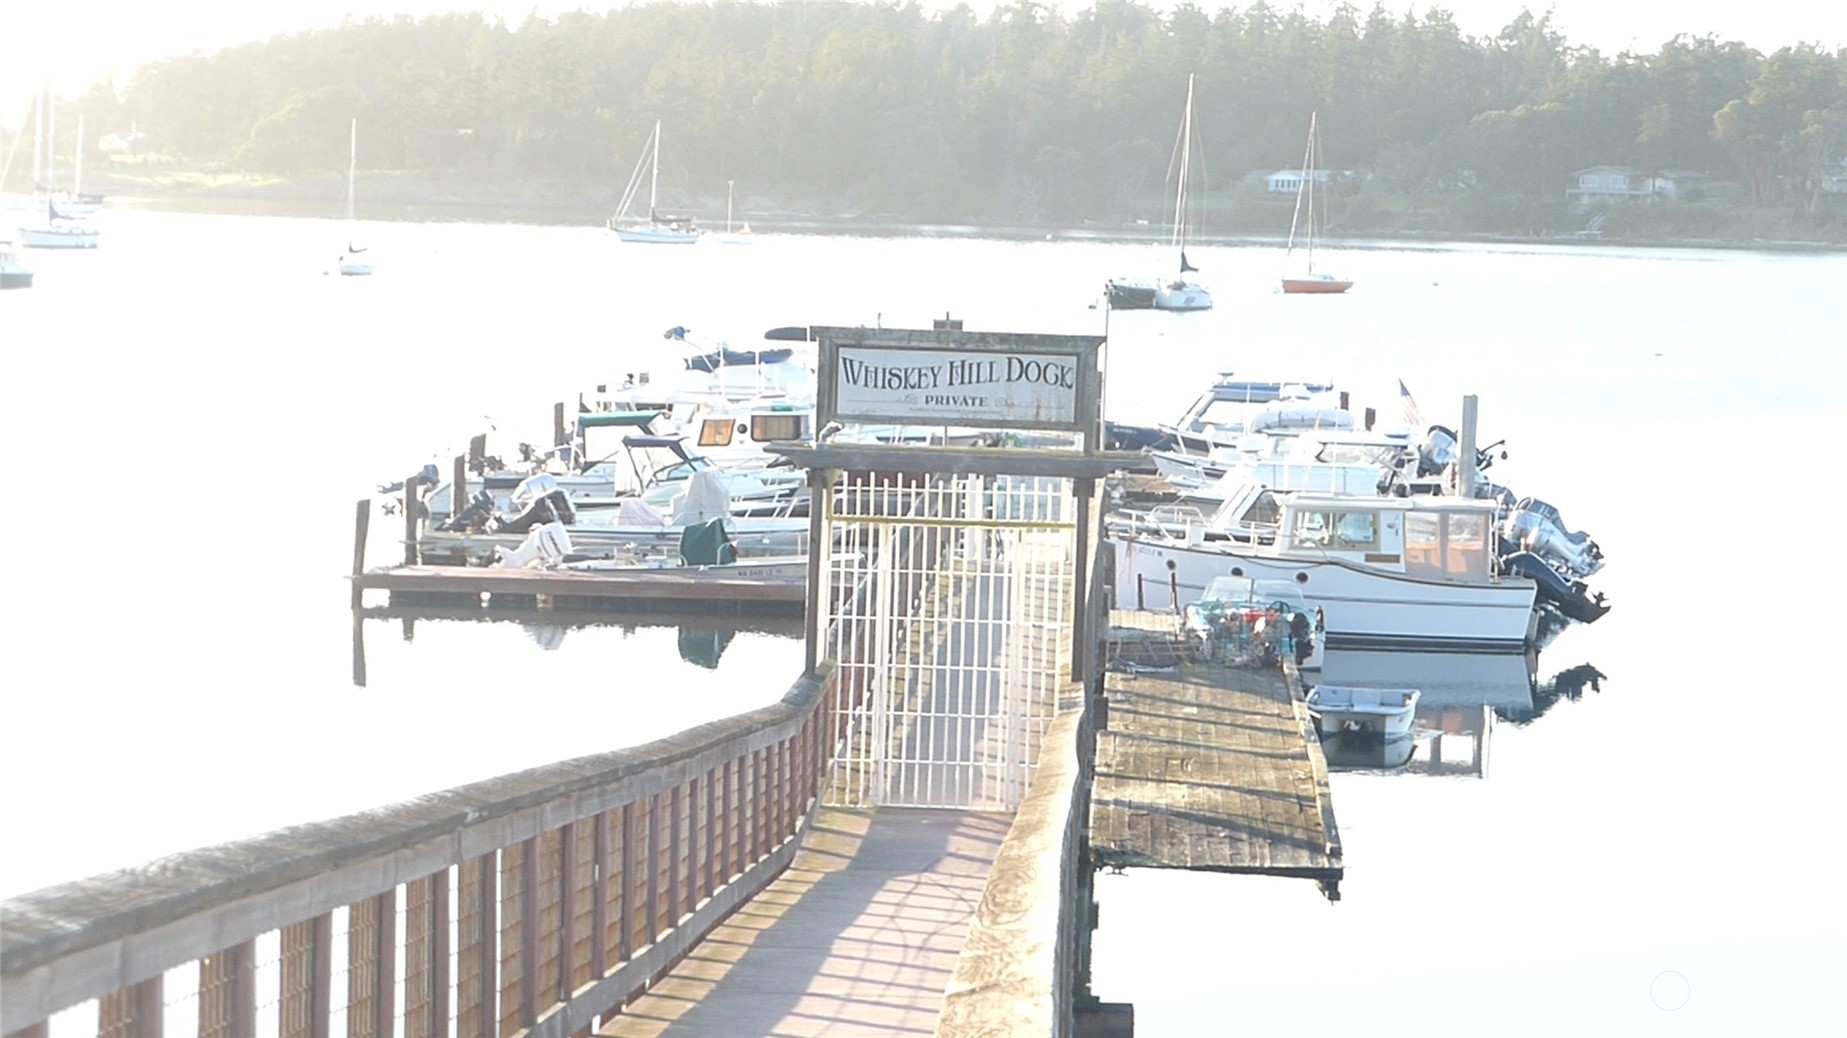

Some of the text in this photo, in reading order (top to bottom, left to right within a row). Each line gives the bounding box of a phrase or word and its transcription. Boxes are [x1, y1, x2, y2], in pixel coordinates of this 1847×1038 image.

[841, 356, 1074, 390] WHISKEY HILL DOCK
[924, 394, 988, 407] PRIVATE
